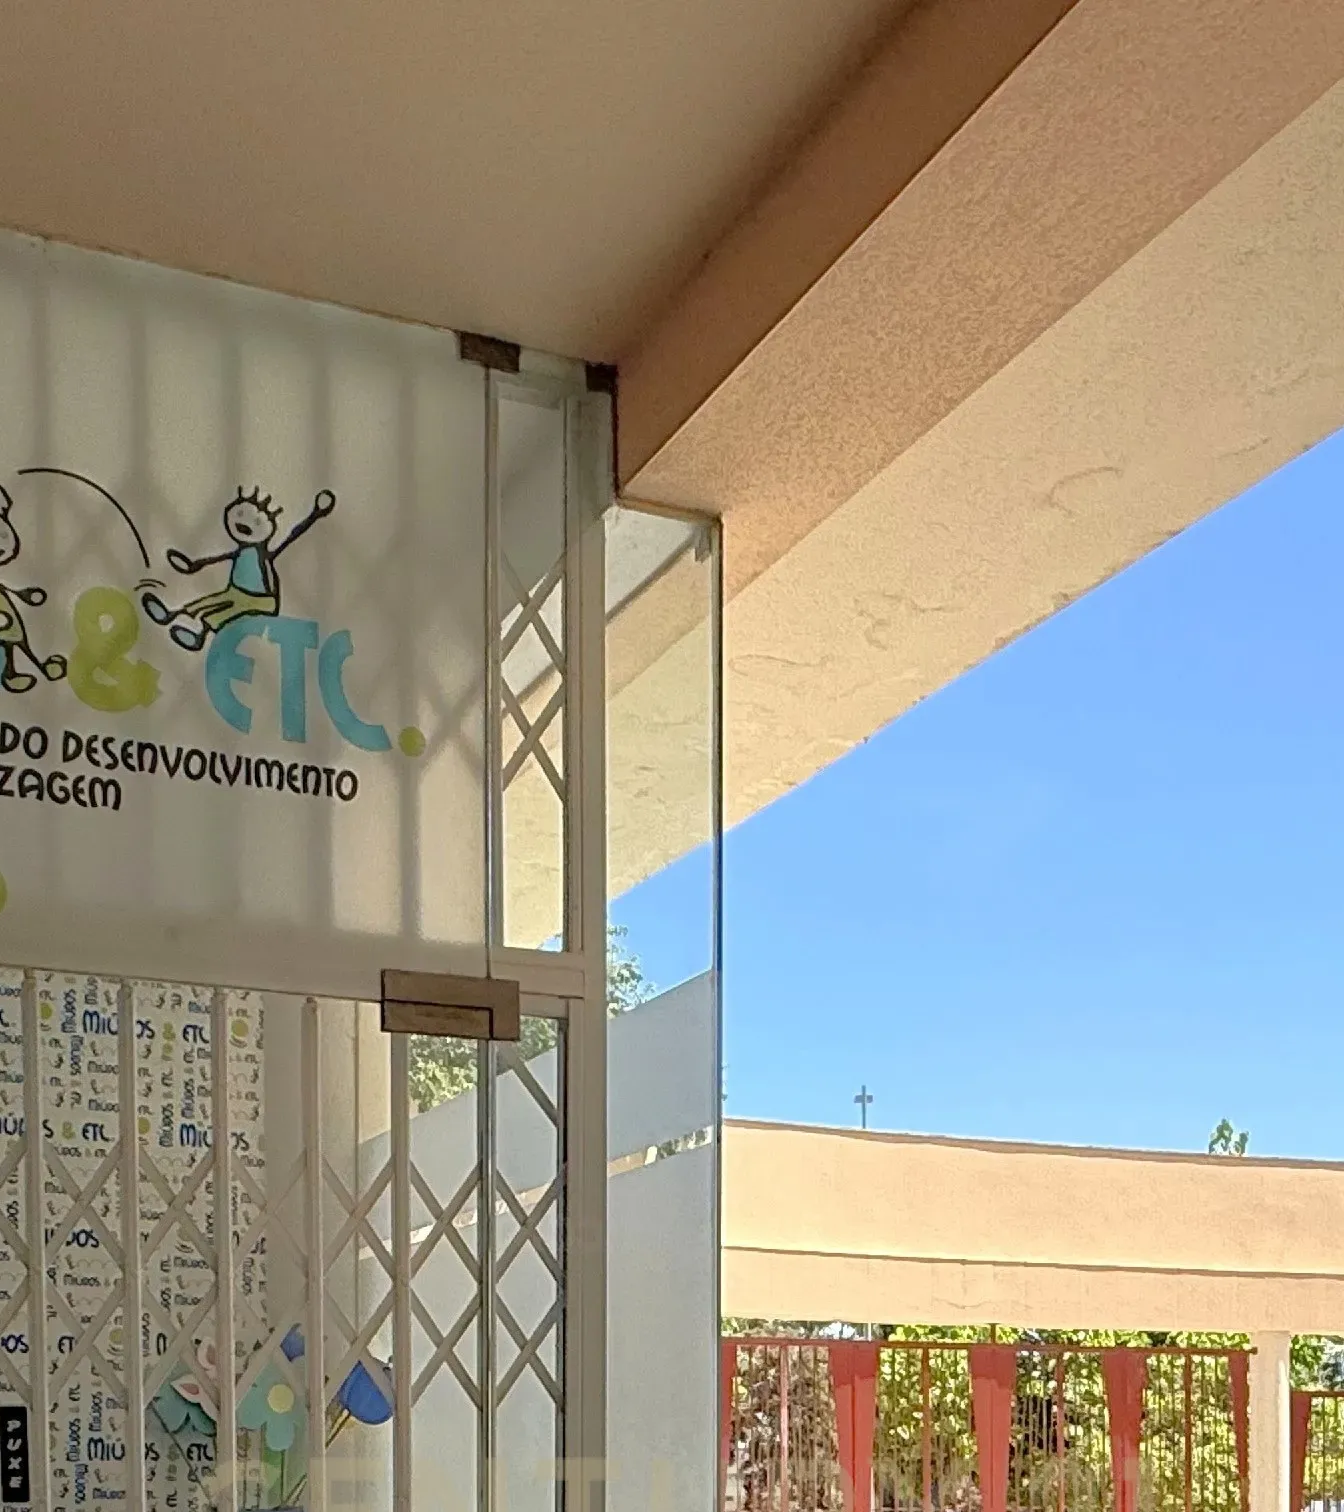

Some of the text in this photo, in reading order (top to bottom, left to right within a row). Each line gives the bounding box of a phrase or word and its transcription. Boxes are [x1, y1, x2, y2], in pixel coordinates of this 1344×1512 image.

[65, 585, 163, 714] &
[61, 728, 360, 803] DESENVOLVIMENTO
[5, 1418, 22, 1490] PUXE
